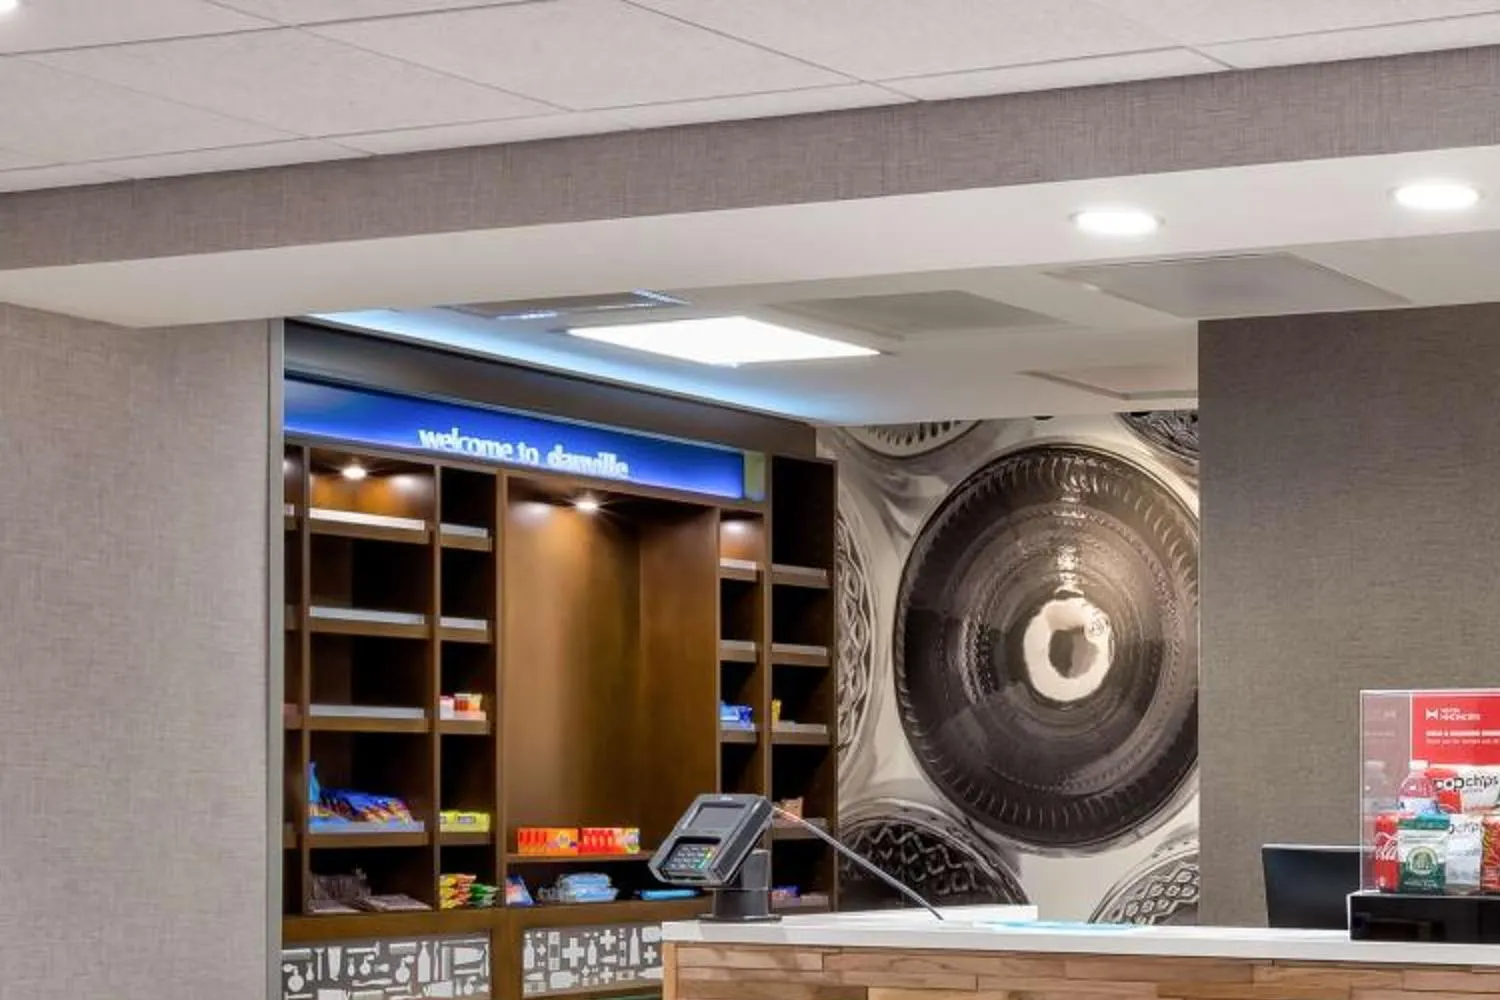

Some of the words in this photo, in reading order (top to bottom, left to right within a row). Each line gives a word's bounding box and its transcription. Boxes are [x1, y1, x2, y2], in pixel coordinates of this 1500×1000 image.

[418, 427, 513, 460] welcome
[518, 441, 539, 466] to
[547, 444, 629, 479] danville
